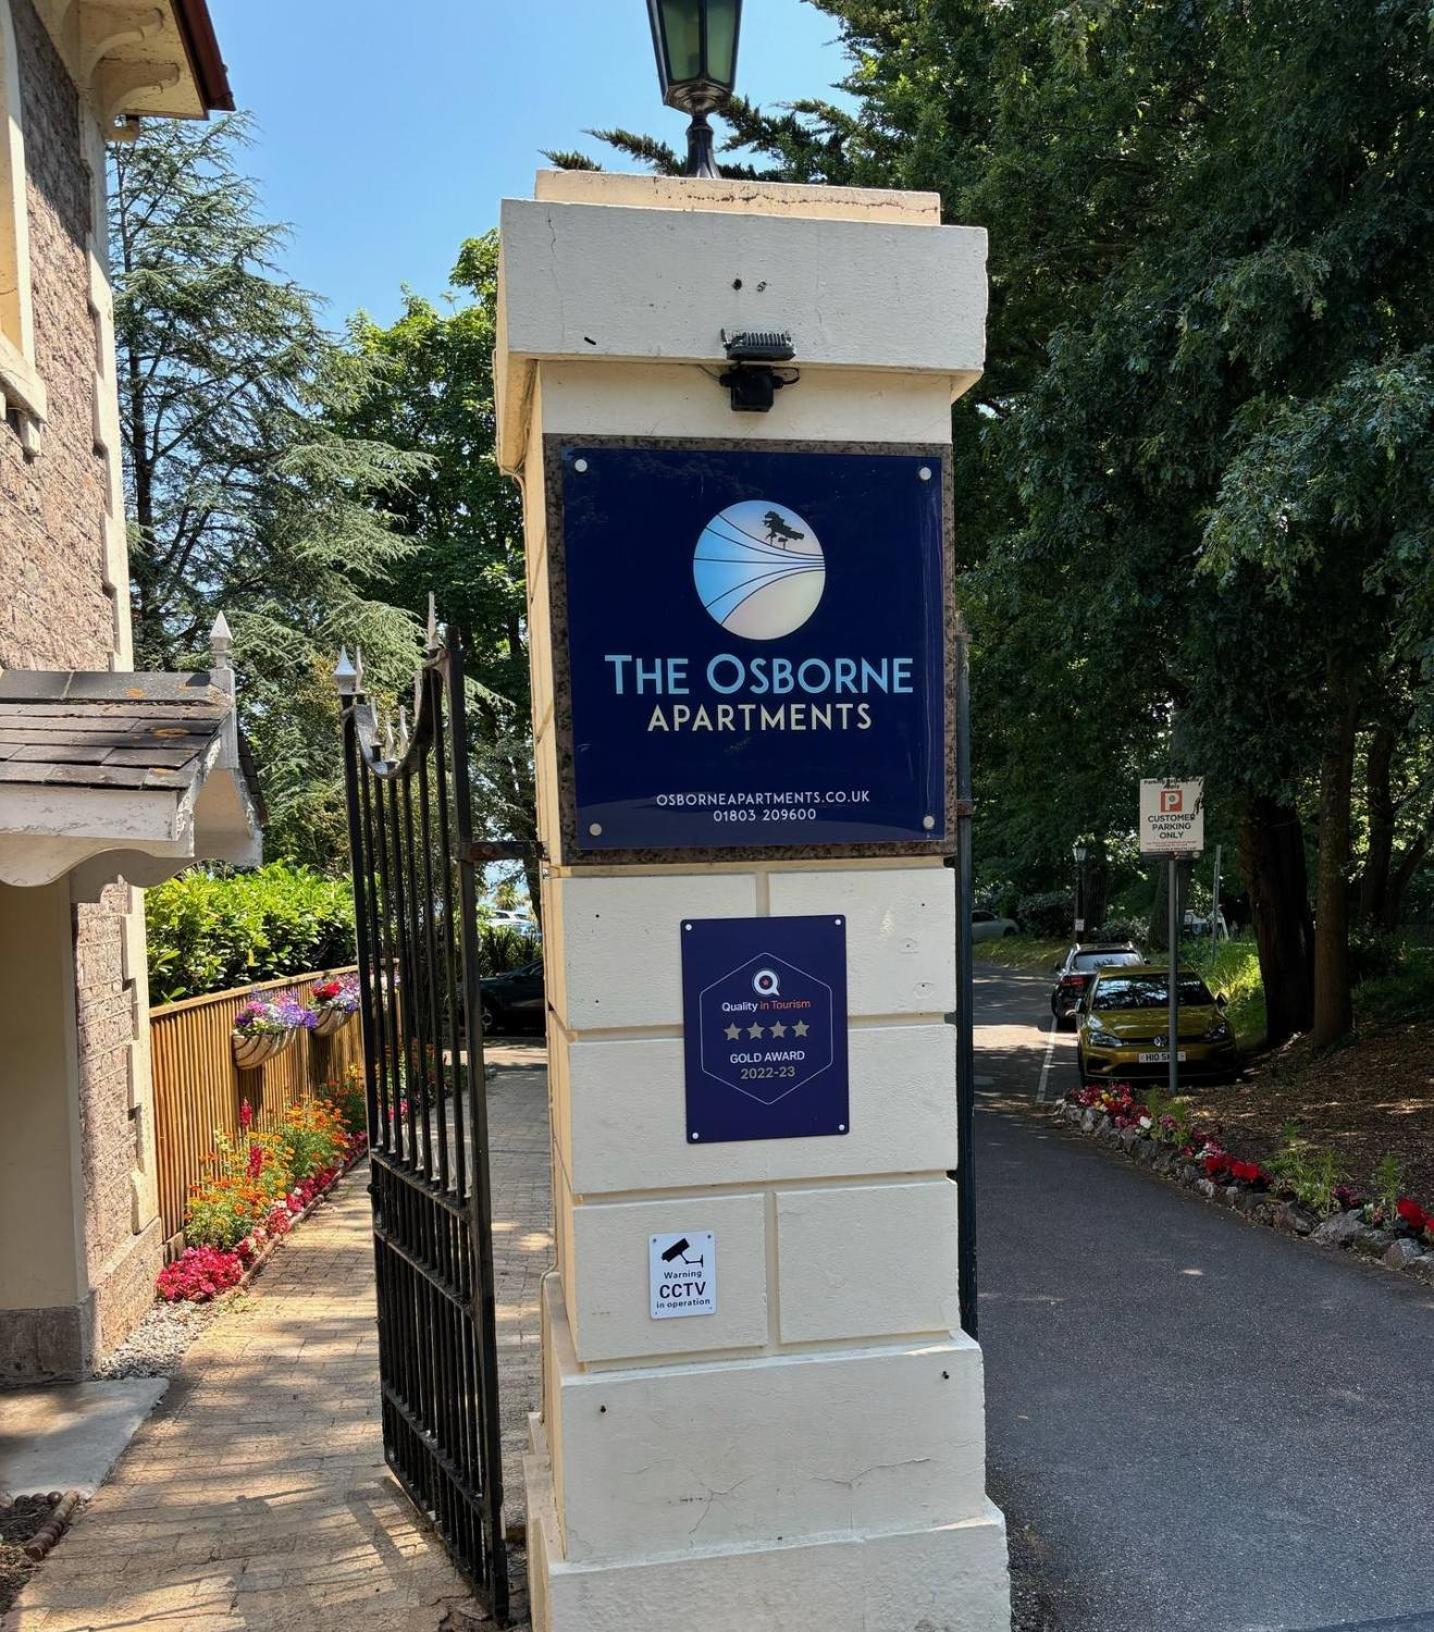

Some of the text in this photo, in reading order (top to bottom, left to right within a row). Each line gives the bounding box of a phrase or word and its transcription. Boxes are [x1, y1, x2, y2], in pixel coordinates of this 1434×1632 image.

[605, 653, 914, 695] THE OSBORNE
[647, 703, 872, 732] APARTMENTS
[656, 790, 870, 807] OSBORNEAPARTMENTS.CO.UK
[713, 808, 816, 823] 01803 209600
[1148, 814, 1195, 823] CUSTOMER
[1152, 822, 1191, 831] PARKING
[1159, 831, 1184, 839] ONLY
[721, 999, 811, 1013] Quality in Tourism
[730, 1051, 805, 1064] GOLD AWARD
[740, 1066, 796, 1080] 2022-23
[664, 1270, 702, 1279] Warning
[659, 1281, 706, 1299] CCTV
[656, 1298, 711, 1309] in operation
